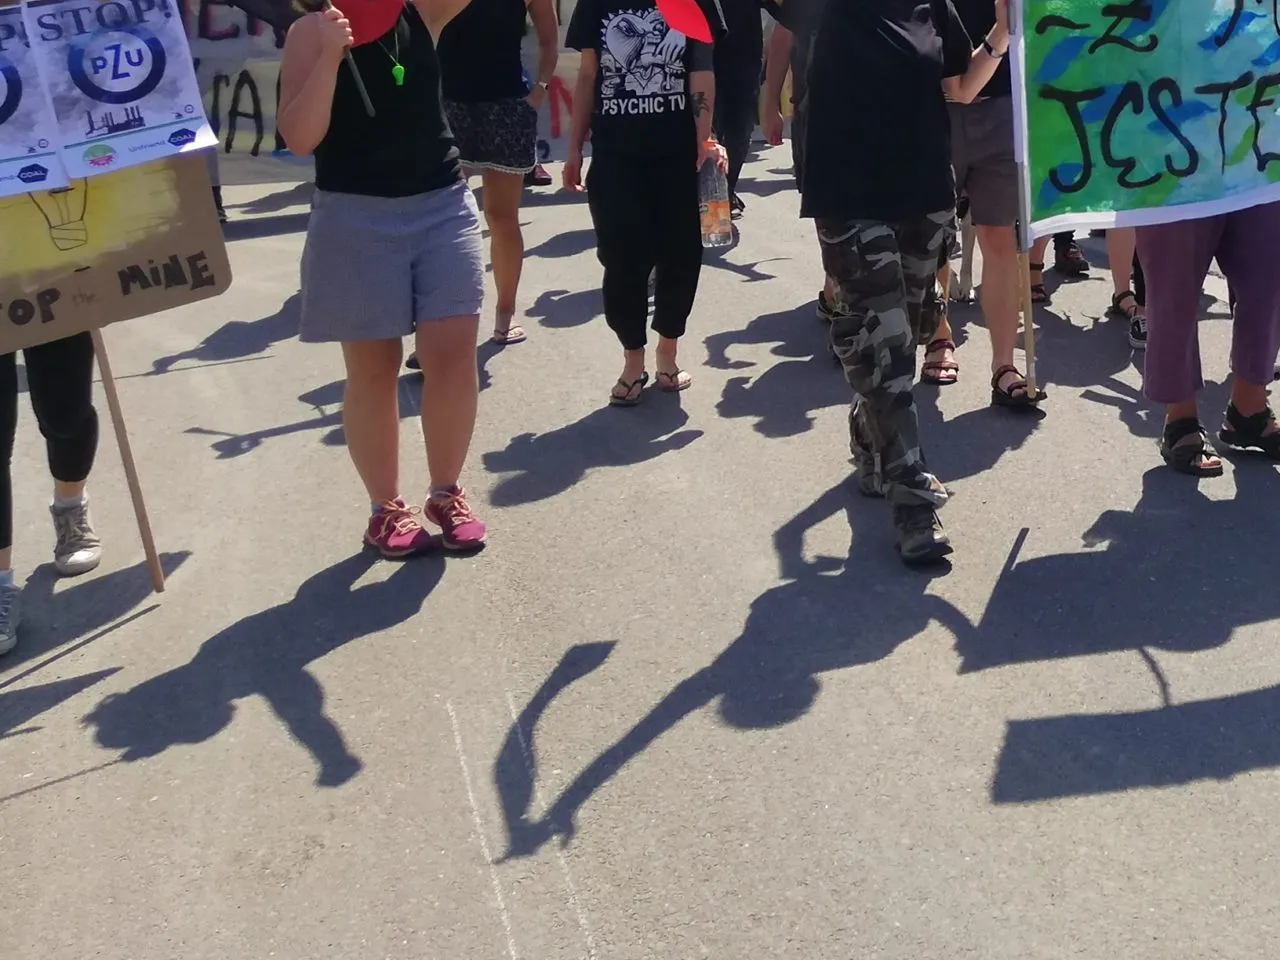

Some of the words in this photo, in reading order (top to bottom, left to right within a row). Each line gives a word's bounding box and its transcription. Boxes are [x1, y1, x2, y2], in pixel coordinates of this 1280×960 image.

[90, 43, 144, 81] PZU
[601, 96, 665, 116] PSYCHIC
[668, 94, 686, 111] TV
[0, 288, 61, 326] OP
